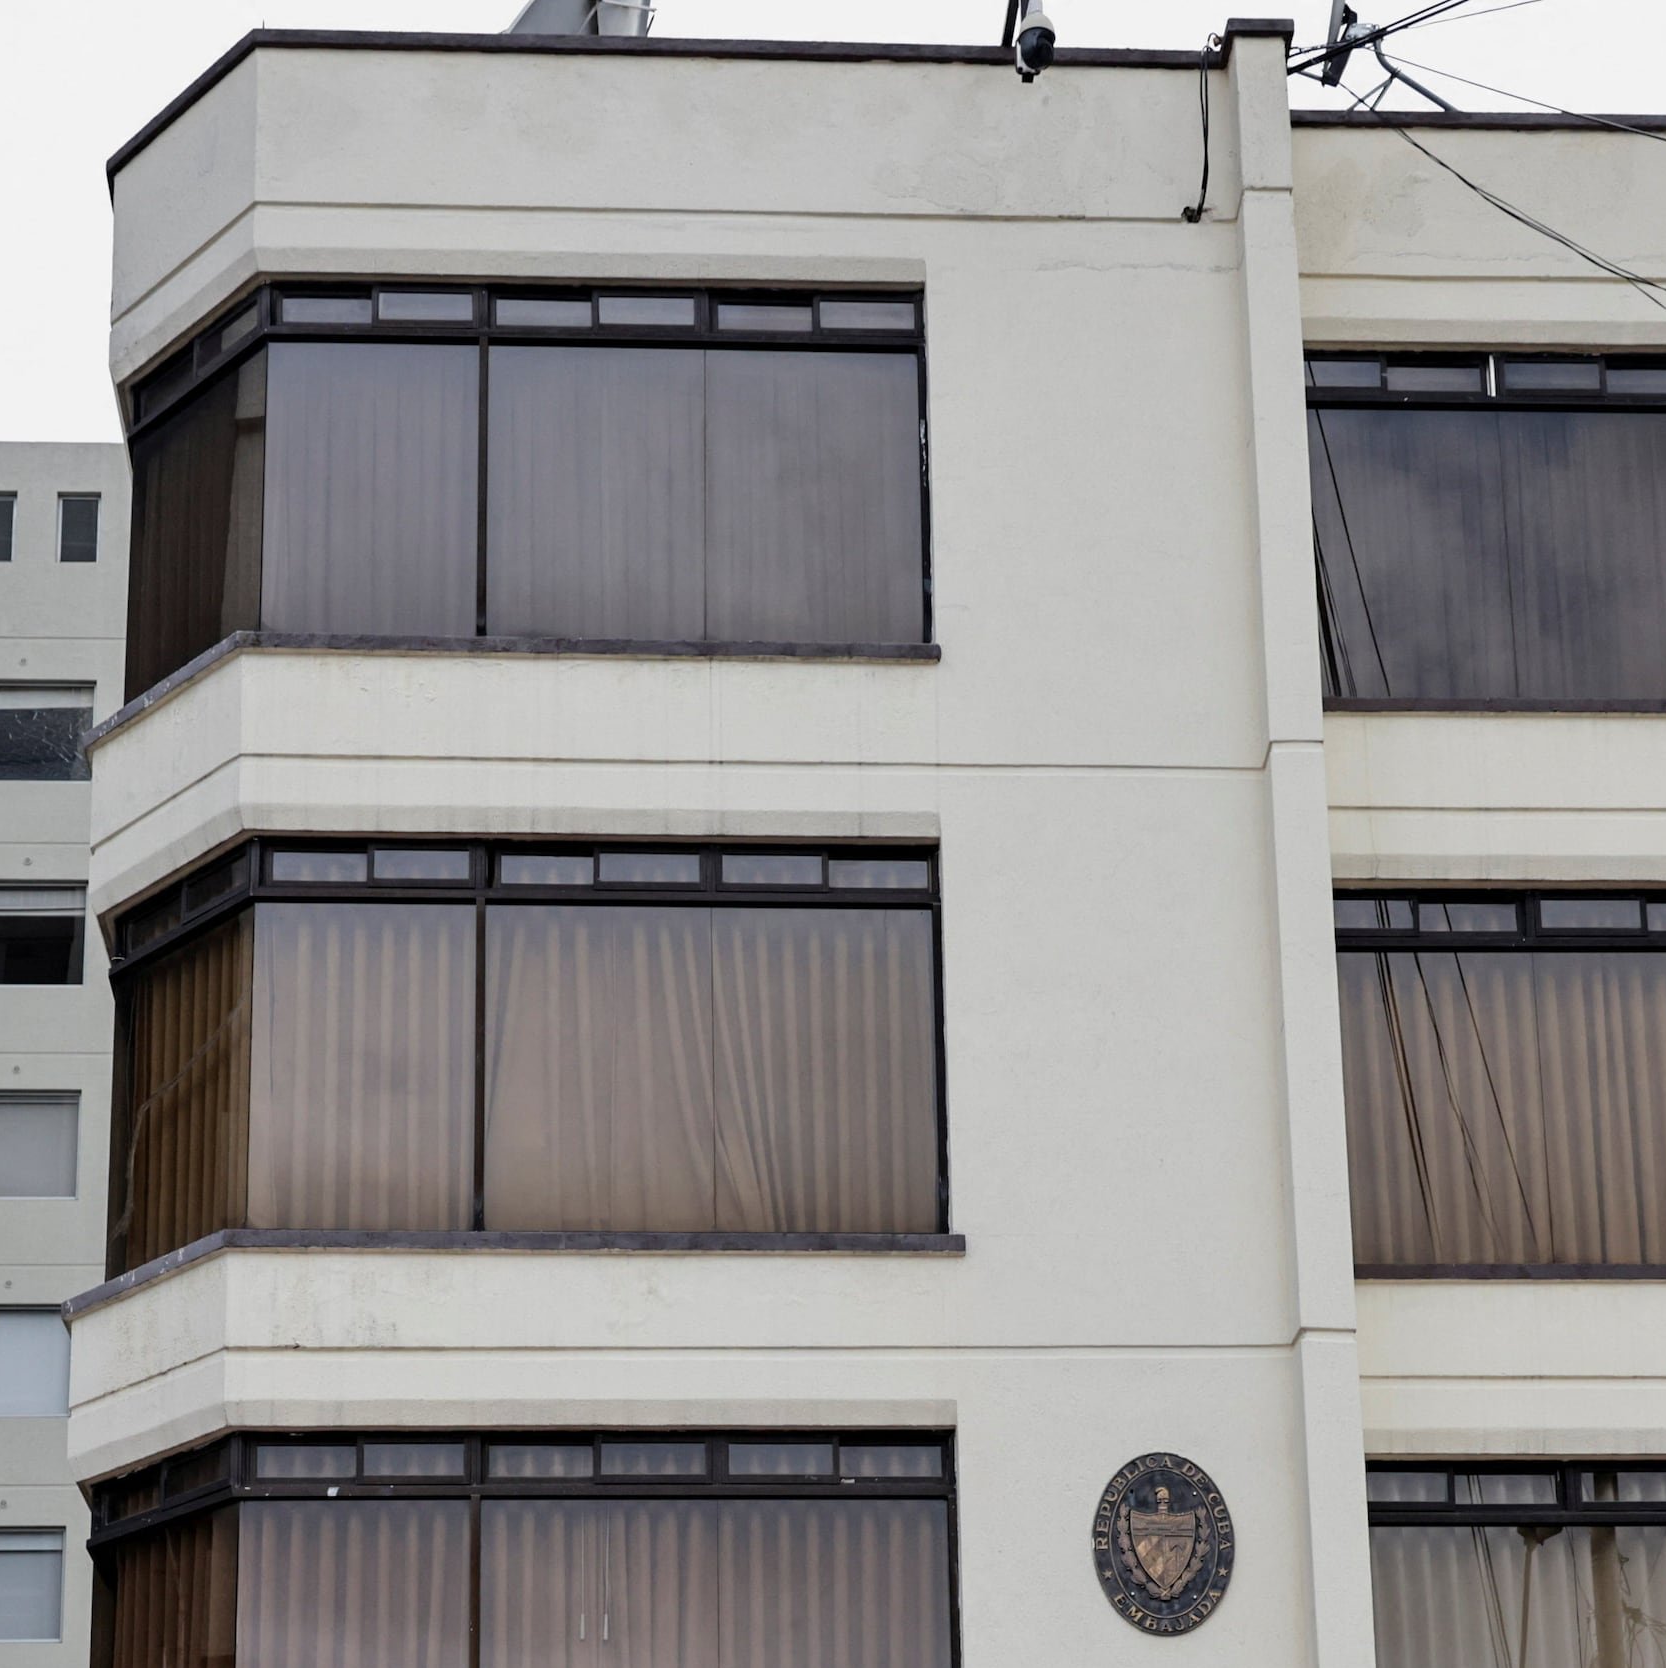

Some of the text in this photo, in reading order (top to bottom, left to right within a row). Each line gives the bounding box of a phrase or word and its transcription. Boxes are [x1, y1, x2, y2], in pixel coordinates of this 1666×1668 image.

[1096, 1456, 1232, 1550] REPUBLICA DE CUBA
[1113, 1590, 1221, 1632] EMBAJADA
